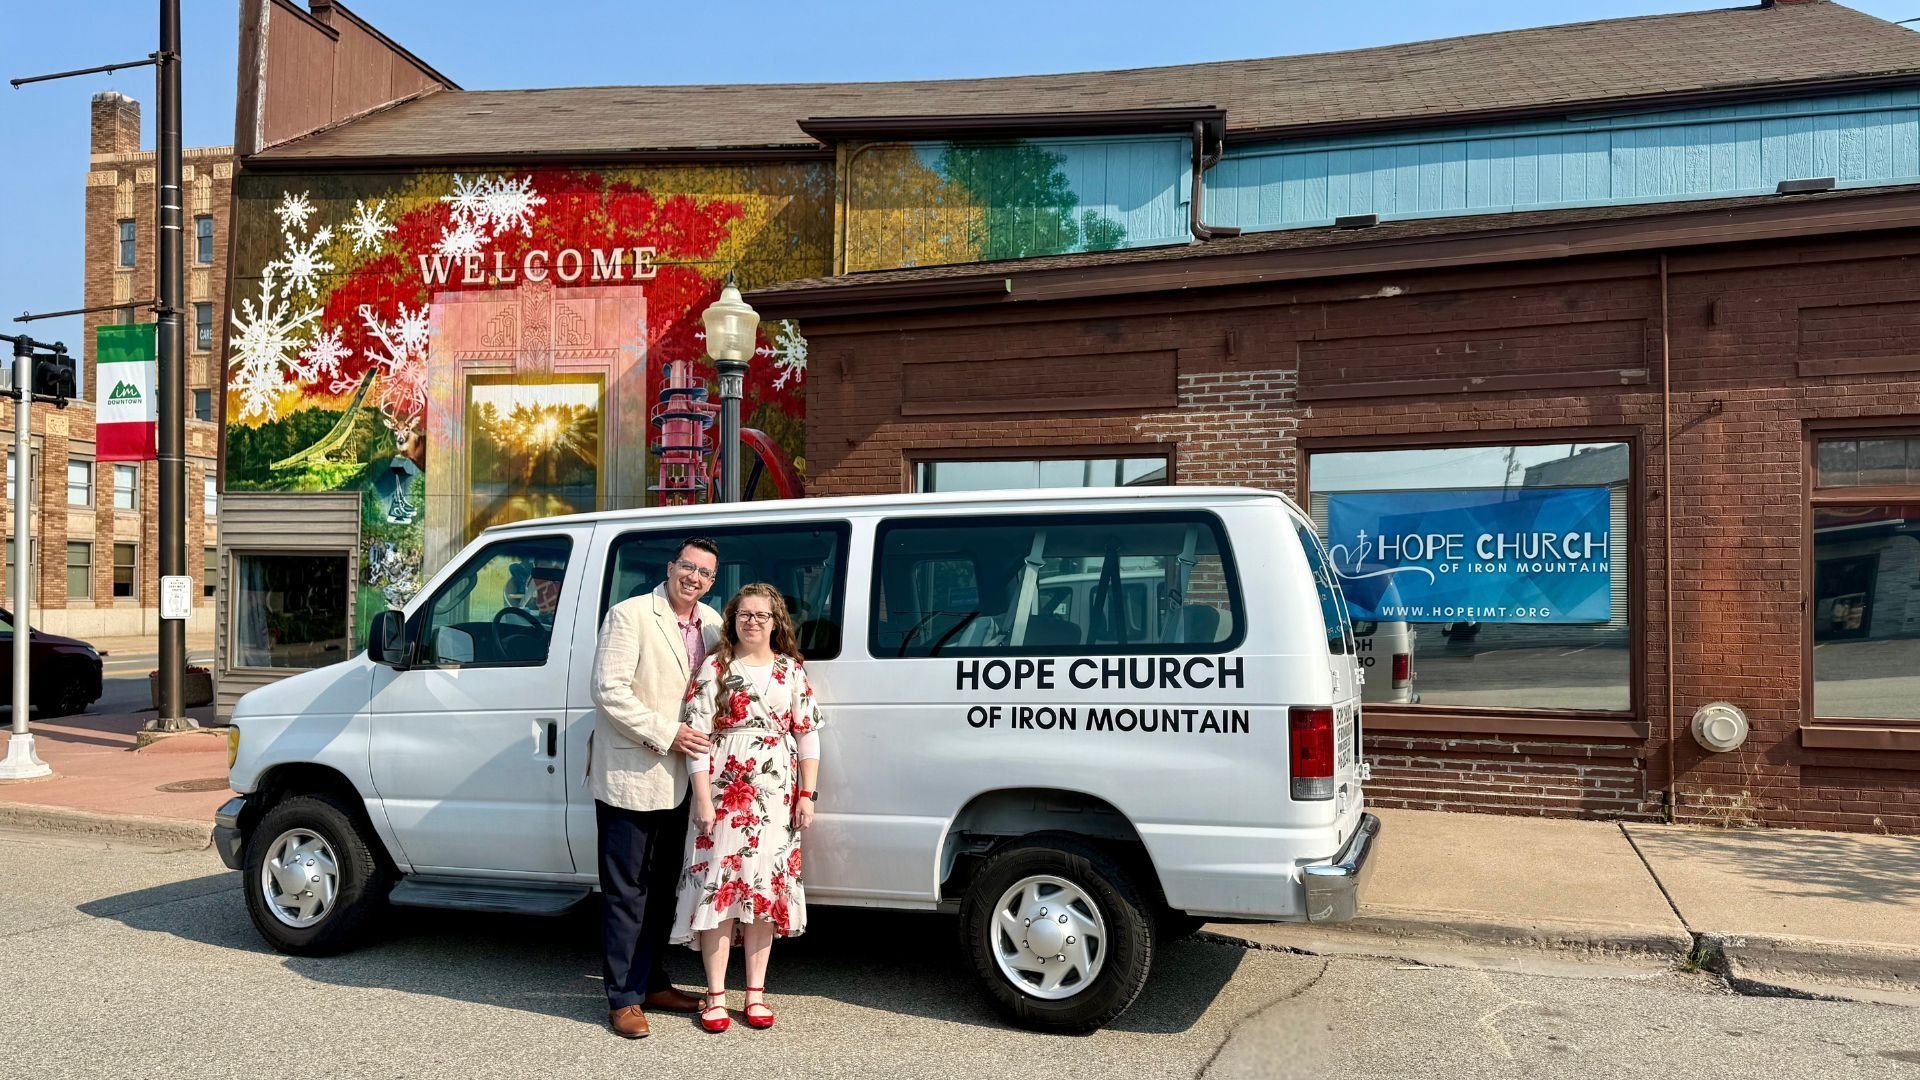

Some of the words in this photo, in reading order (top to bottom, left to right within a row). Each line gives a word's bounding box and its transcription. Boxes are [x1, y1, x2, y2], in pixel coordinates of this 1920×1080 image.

[418, 246, 658, 285] WELCOME
[107, 398, 142, 406] DOWNTOWN
[1378, 533, 1464, 561] HOPE
[1476, 531, 1608, 560] CHURCH
[1439, 562, 1460, 573] OF
[1468, 562, 1508, 573] IRON
[1516, 562, 1609, 573] MOUNTAIN
[1382, 606, 1551, 617] WWW.HOPEIMT.ORG
[956, 658, 1055, 691] HOPE
[1068, 656, 1244, 689] CHURCH
[967, 705, 1002, 729] OF
[1011, 706, 1077, 730] IRON
[1085, 708, 1250, 734] MOUNTAIN
